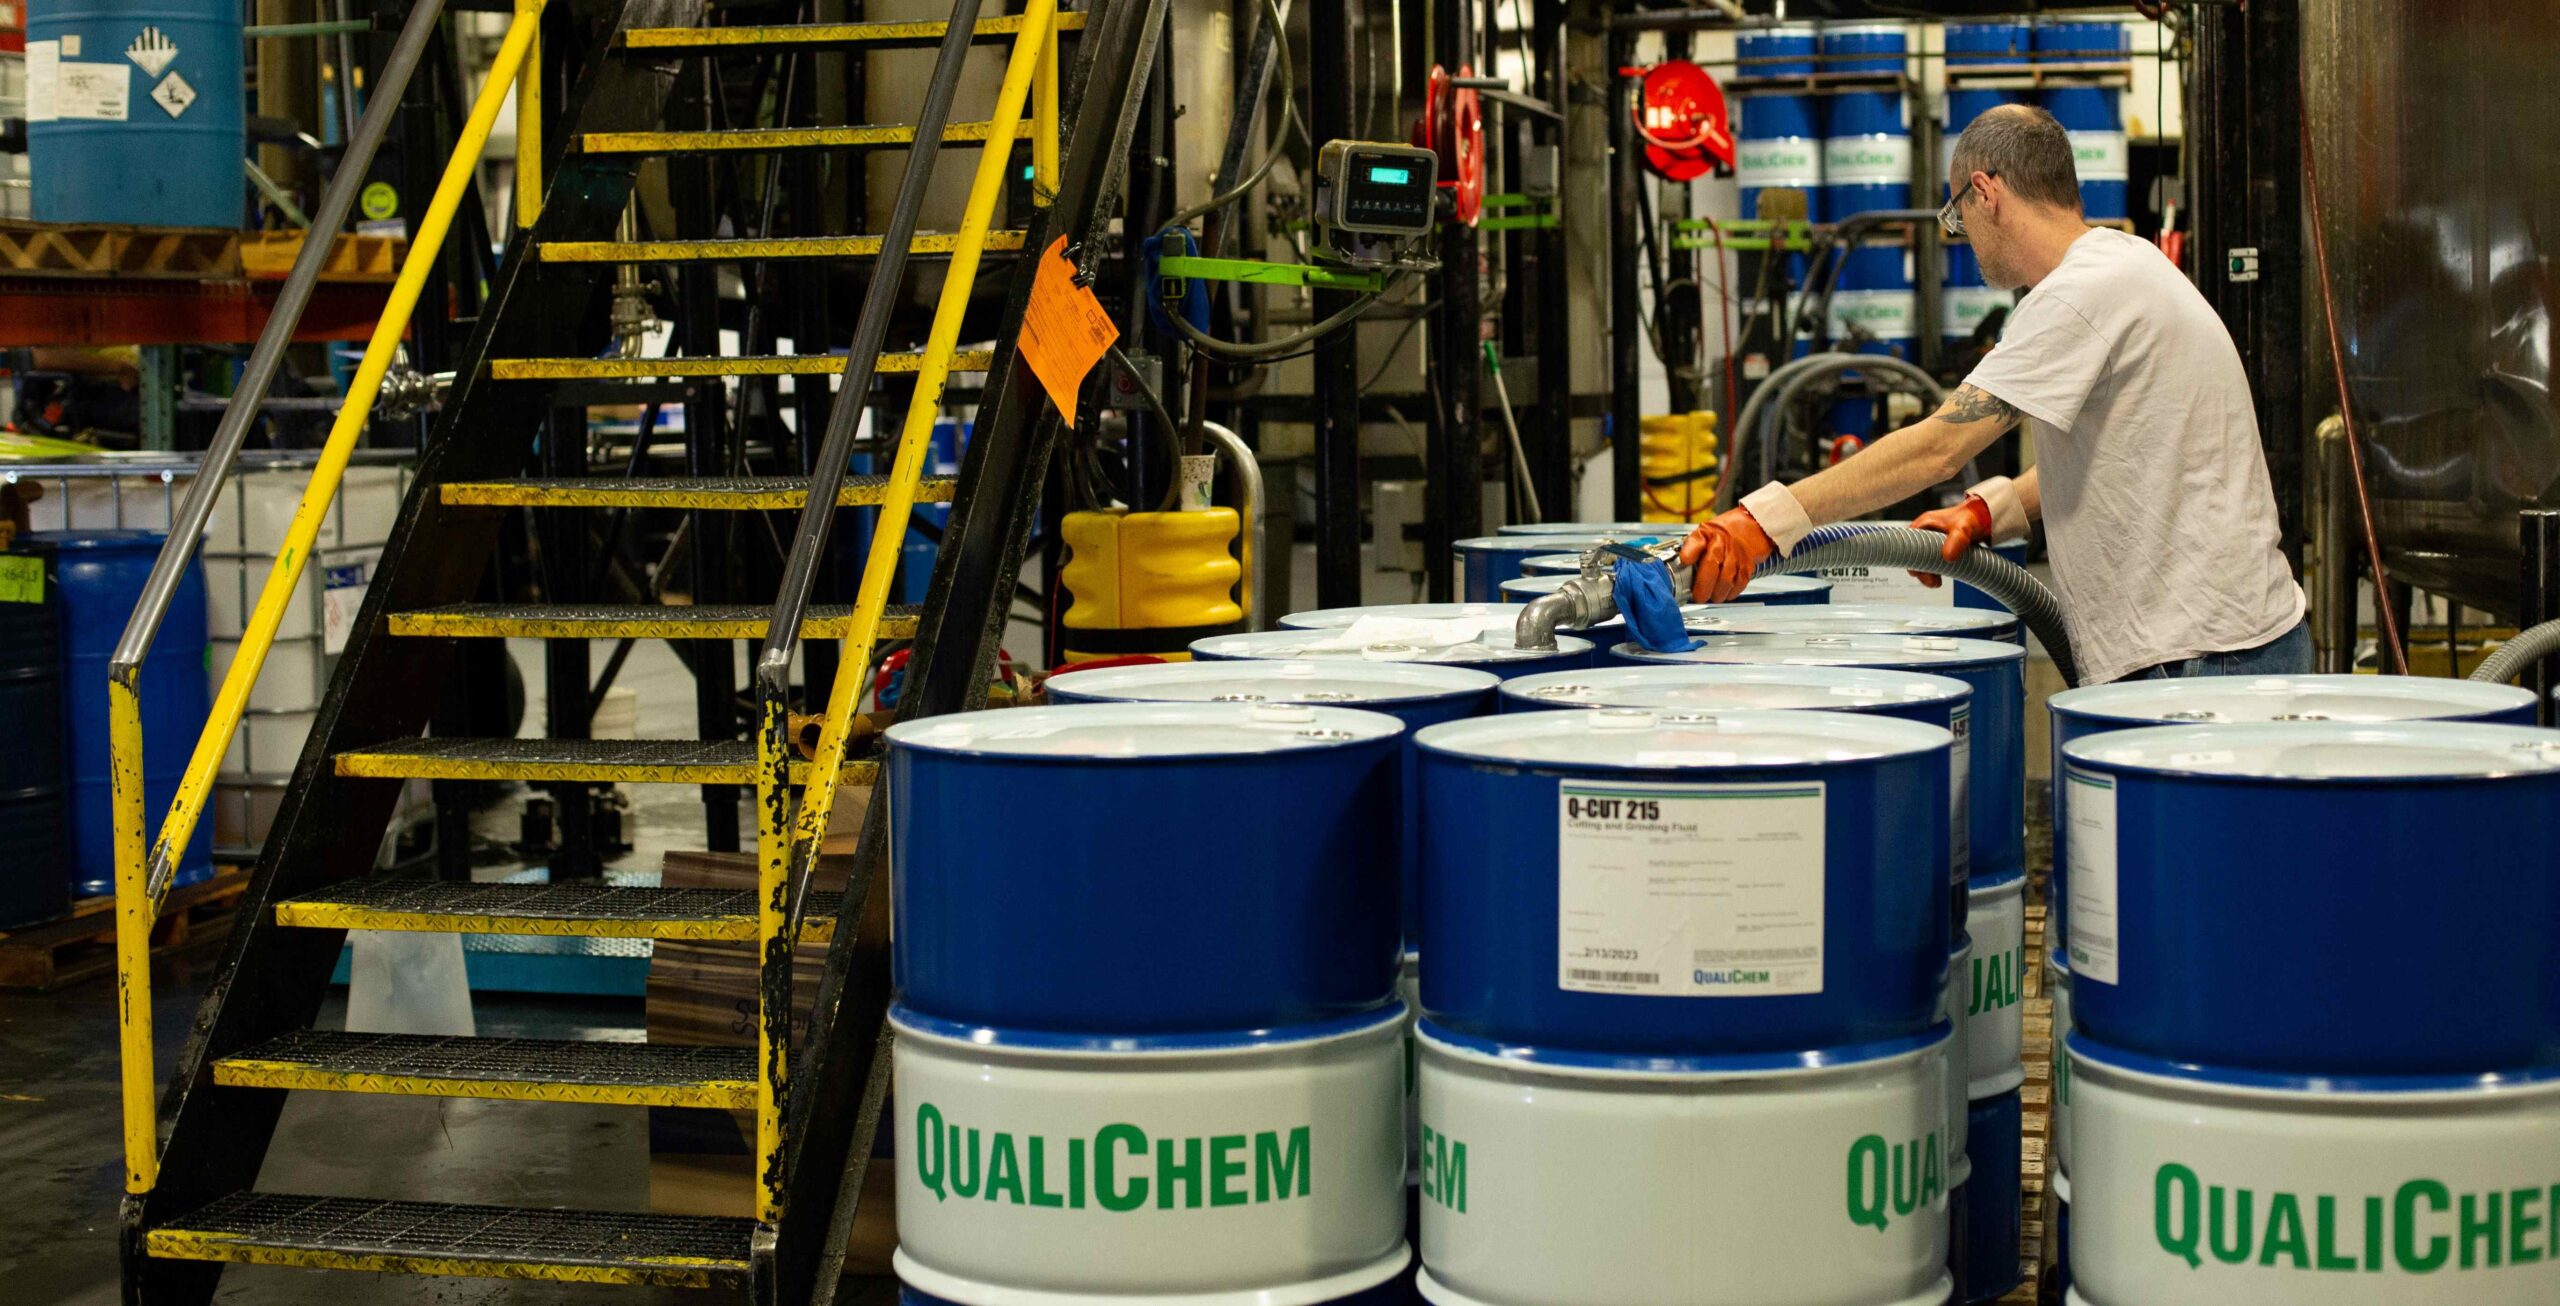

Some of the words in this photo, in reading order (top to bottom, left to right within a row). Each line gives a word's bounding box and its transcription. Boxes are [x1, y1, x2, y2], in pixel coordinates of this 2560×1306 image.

[1851, 567, 1869, 577] 215
[1568, 797, 1621, 820] Q-CUT
[1626, 800, 1660, 821] 215
[1567, 820, 1602, 831] Cutting
[1604, 822, 1623, 830] and
[1625, 822, 1669, 833] Grinding
[1671, 823, 1699, 833] Fluid
[1584, 947, 1638, 961] 2/13/2023
[1694, 969, 1770, 985] QUALICHEM
[917, 1102, 1311, 1213] QUALICHEM
[2155, 1162, 2560, 1275] QUALICHE
